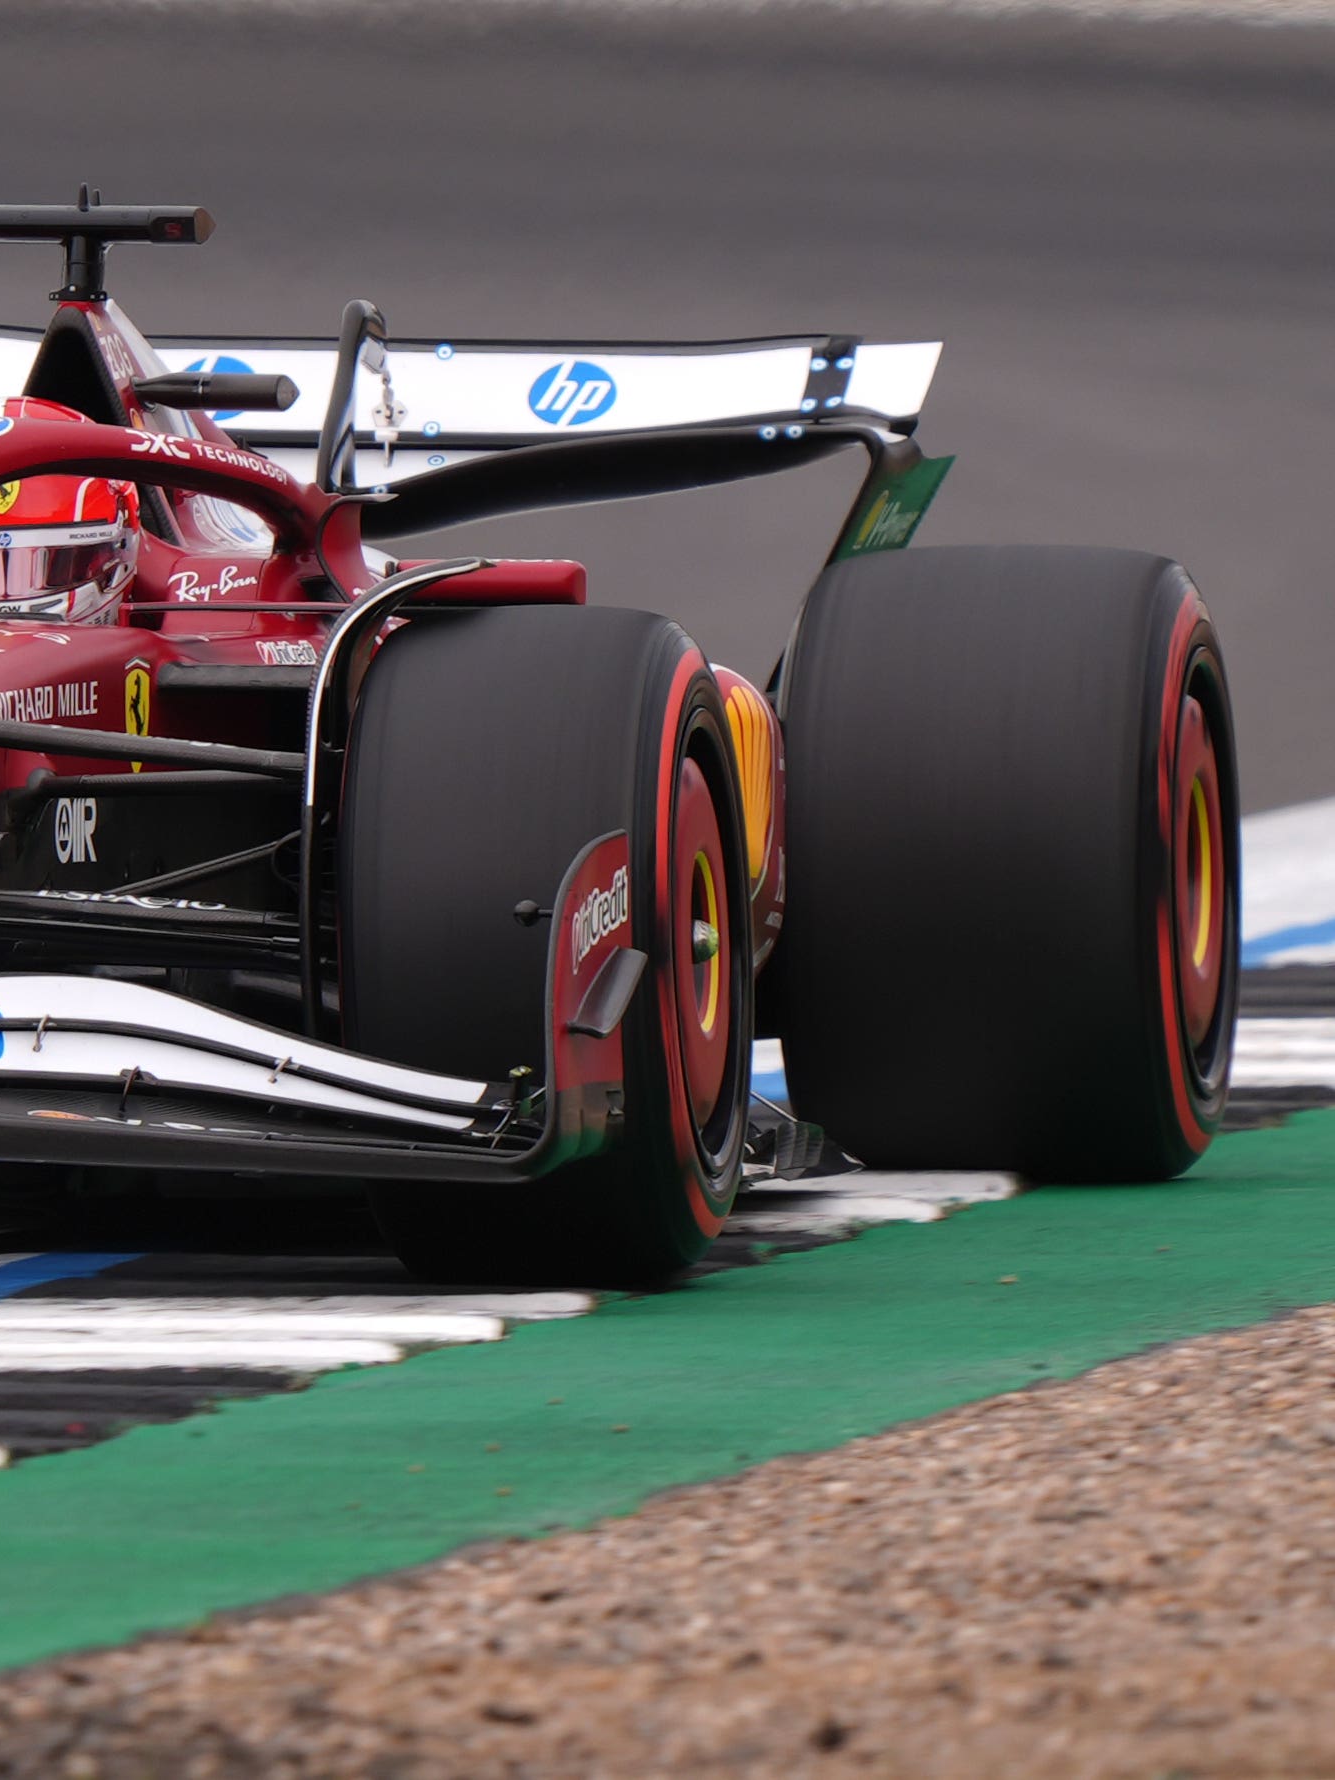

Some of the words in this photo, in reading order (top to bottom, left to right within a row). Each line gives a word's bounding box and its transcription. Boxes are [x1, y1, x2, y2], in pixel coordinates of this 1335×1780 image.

[534, 360, 612, 425] hp
[125, 428, 191, 460] DXC
[192, 442, 288, 485] TECHNOLOGY
[167, 565, 258, 602] Ray-Ban
[57, 681, 99, 718] MILLE
